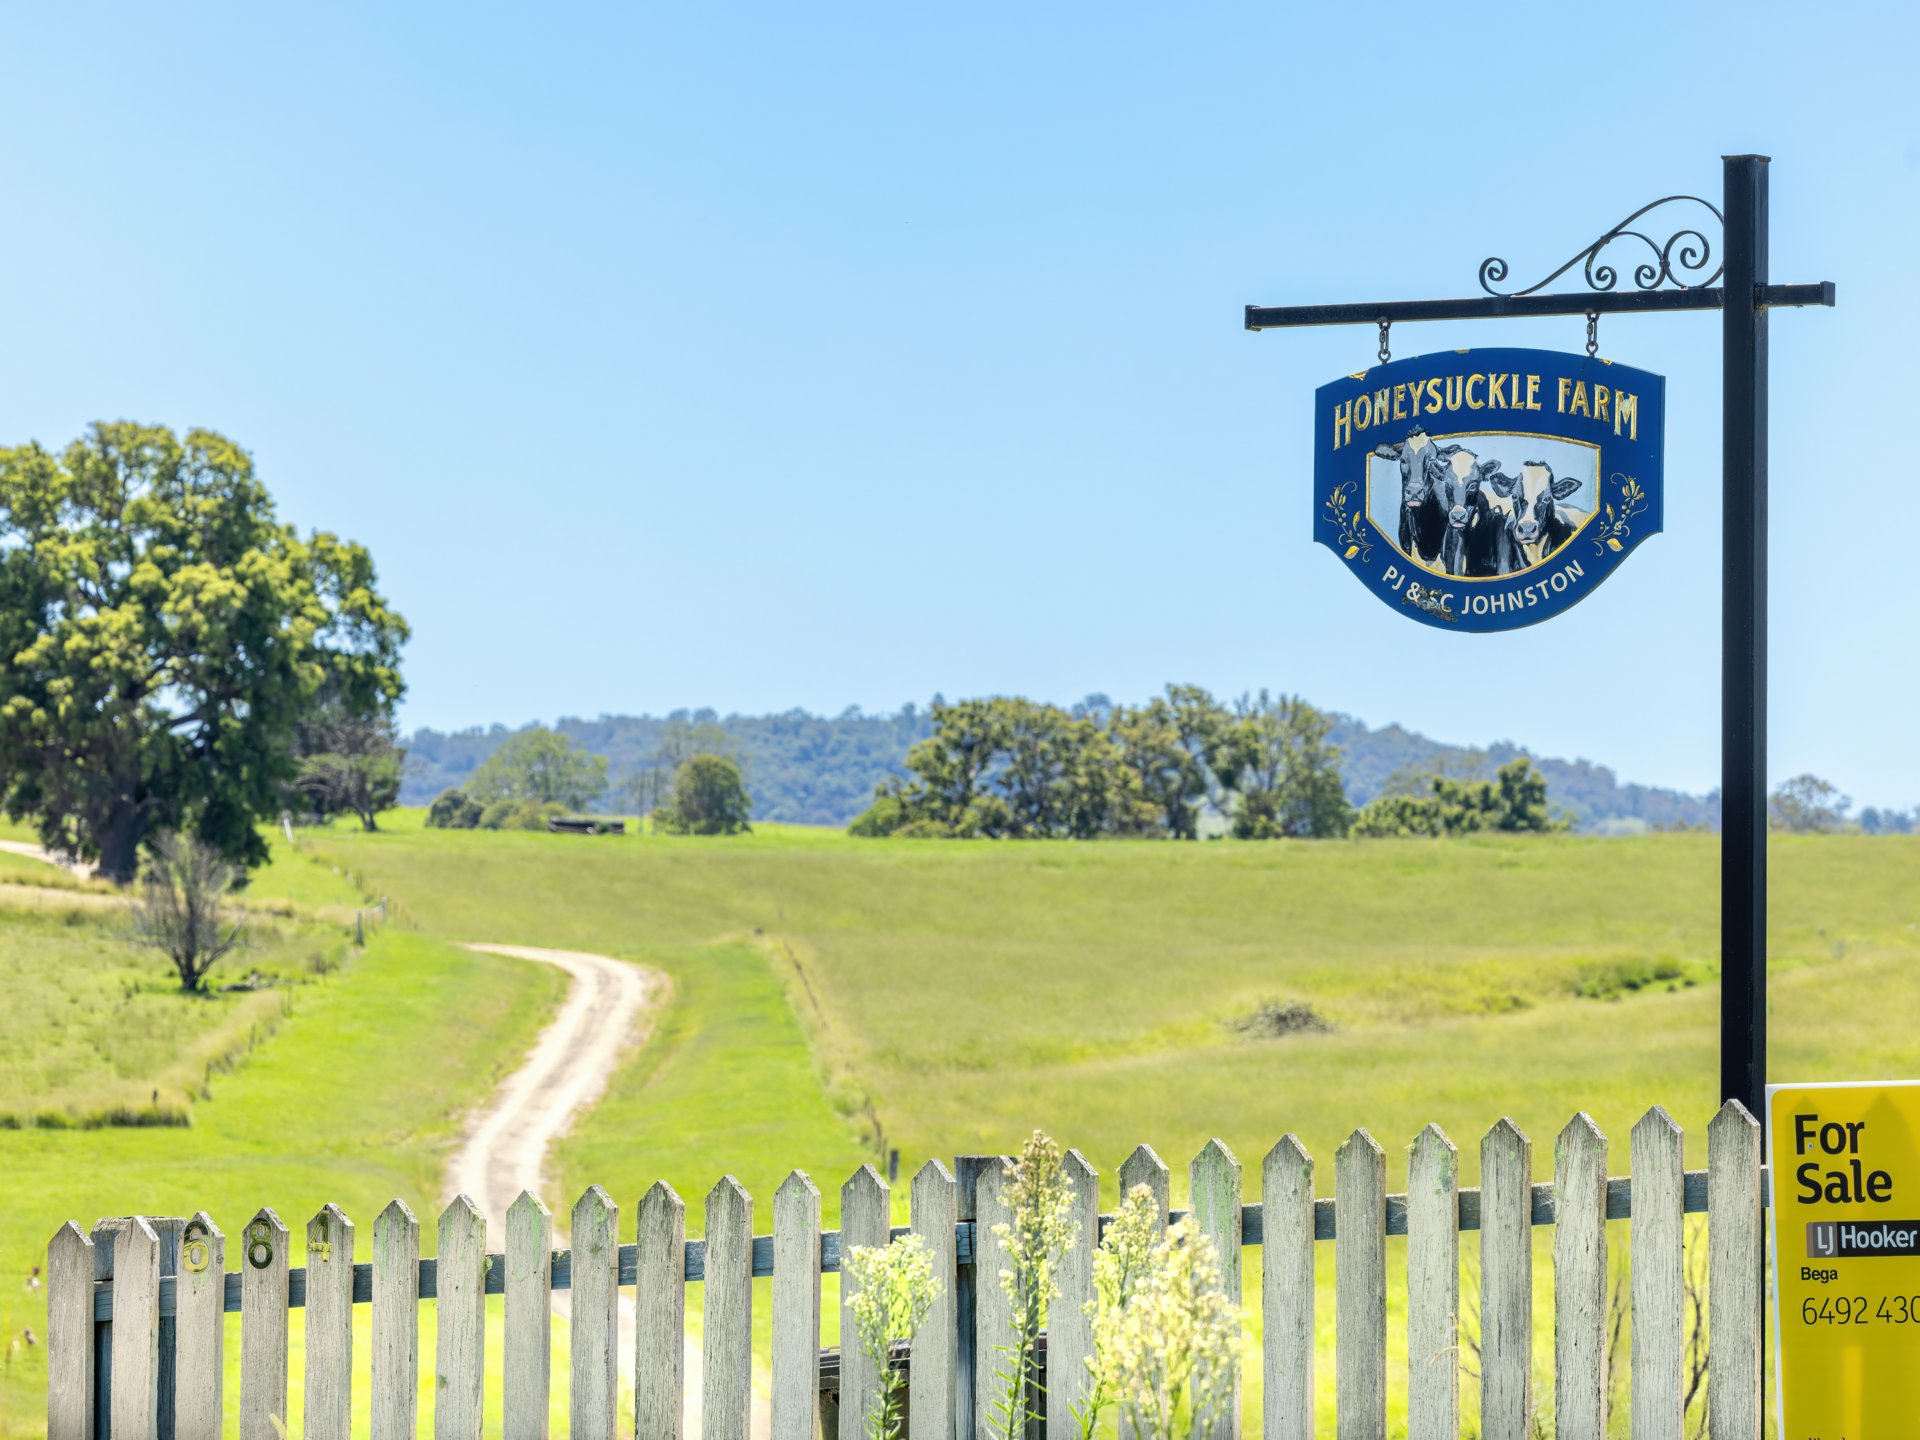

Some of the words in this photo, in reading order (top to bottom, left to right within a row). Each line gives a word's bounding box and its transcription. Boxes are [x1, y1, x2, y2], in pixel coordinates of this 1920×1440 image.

[1333, 373, 1541, 451] HONEYSUCKLE
[1558, 377, 1639, 441] FARM
[1382, 565, 1406, 590] PJ
[1406, 582, 1421, 603] &
[1461, 560, 1585, 614] JOHNSTON
[1795, 1113, 1865, 1155] For
[1796, 1159, 1893, 1204] Sale
[1817, 1225, 1834, 1255] LJ
[1841, 1224, 1918, 1249] Hooker
[1801, 1267, 1838, 1284] Bega
[1802, 1296, 1868, 1325] 6492
